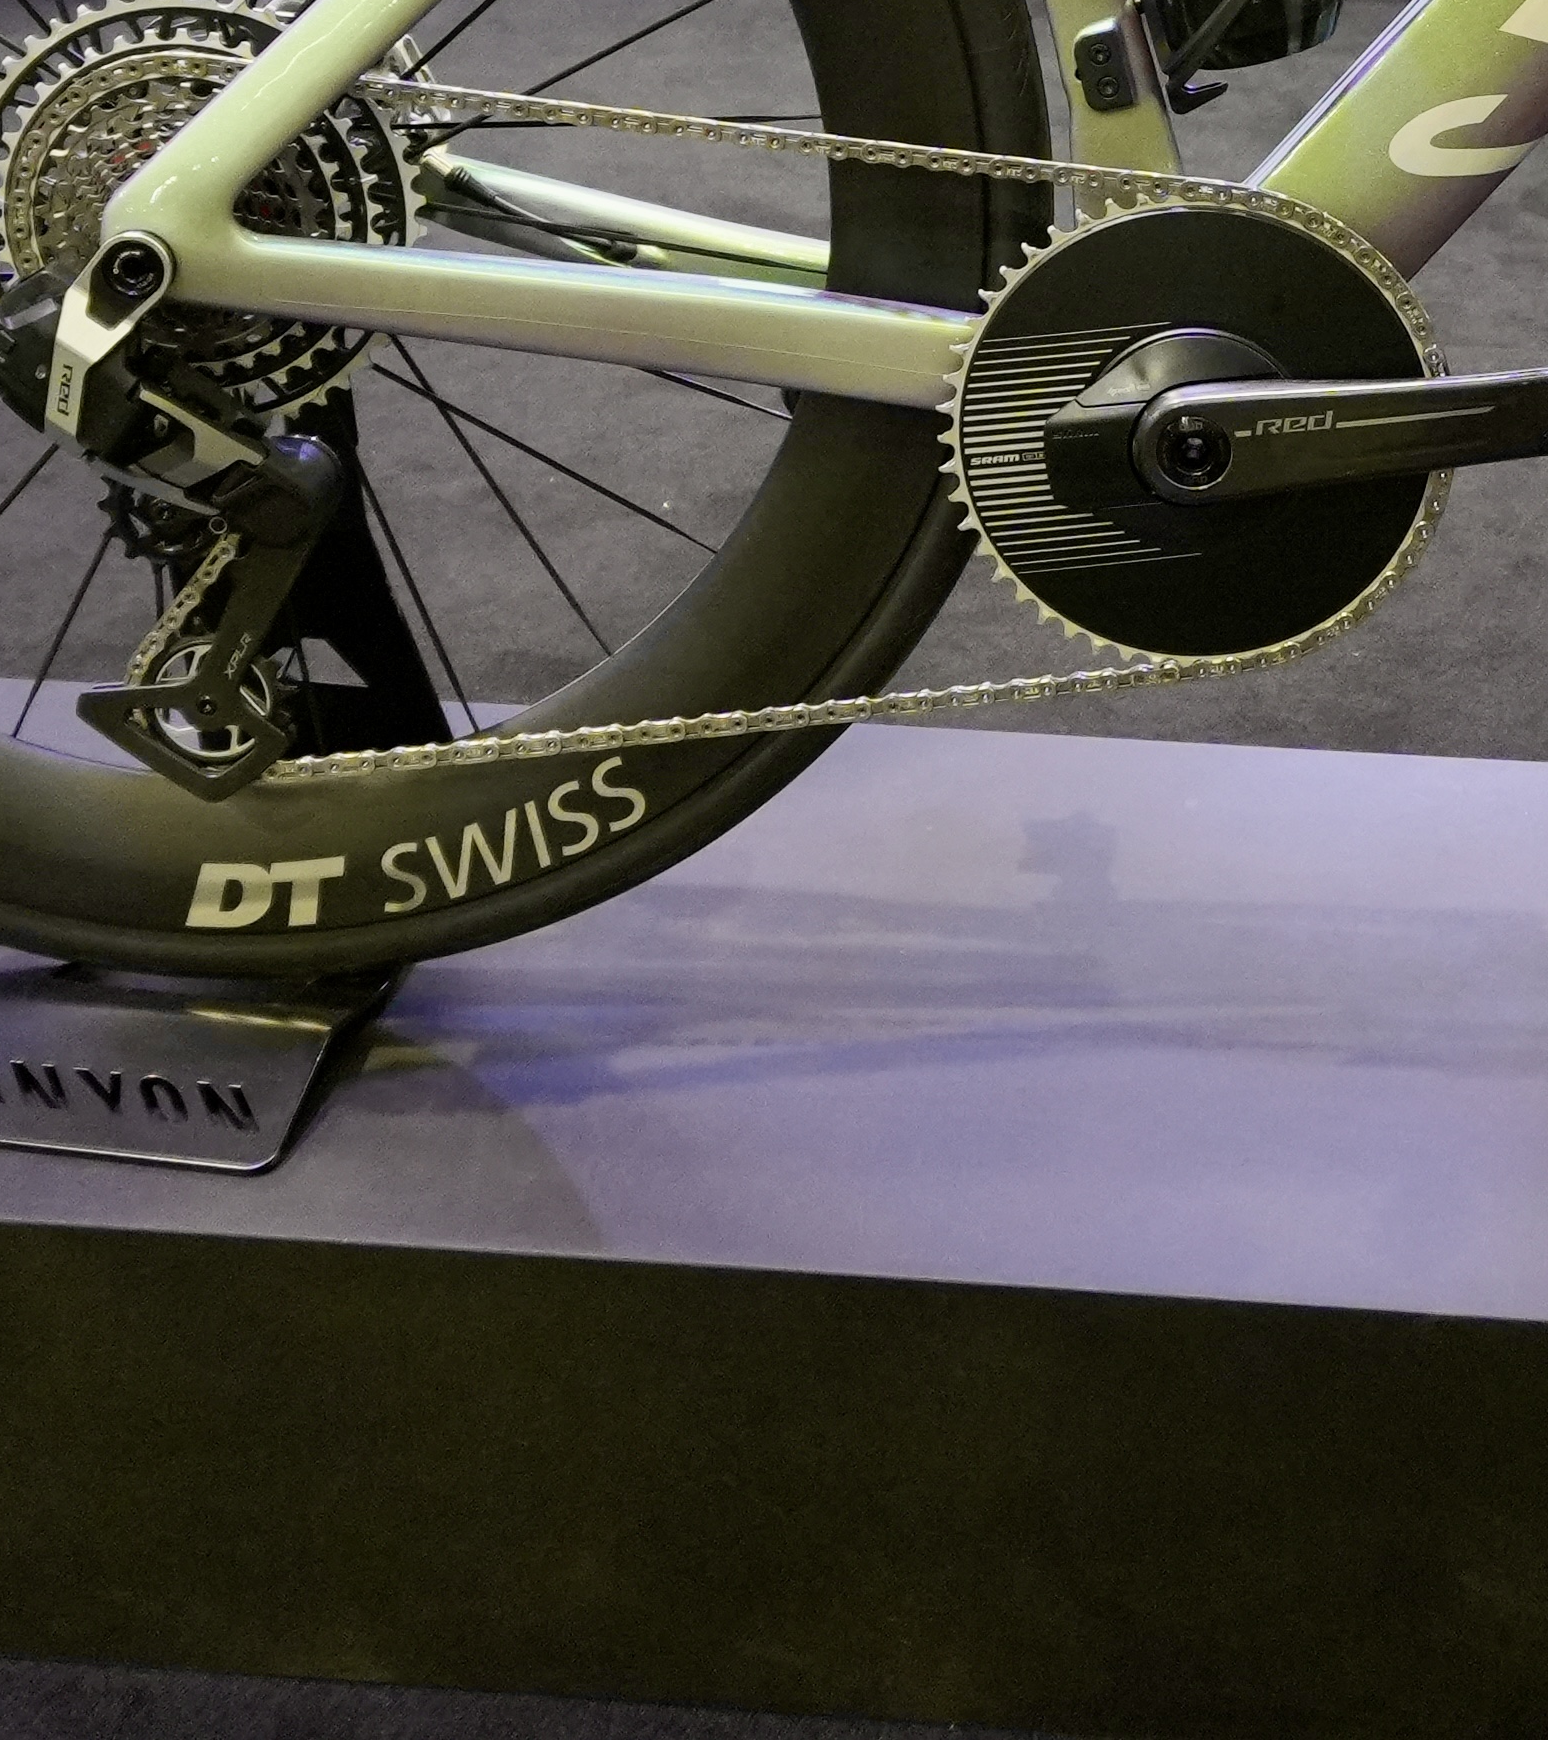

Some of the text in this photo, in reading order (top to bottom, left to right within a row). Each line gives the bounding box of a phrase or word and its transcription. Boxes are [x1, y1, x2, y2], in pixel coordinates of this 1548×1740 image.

[970, 453, 1020, 466] SRAM
[223, 632, 252, 679] XPLR
[185, 756, 647, 928] DT SWISS
